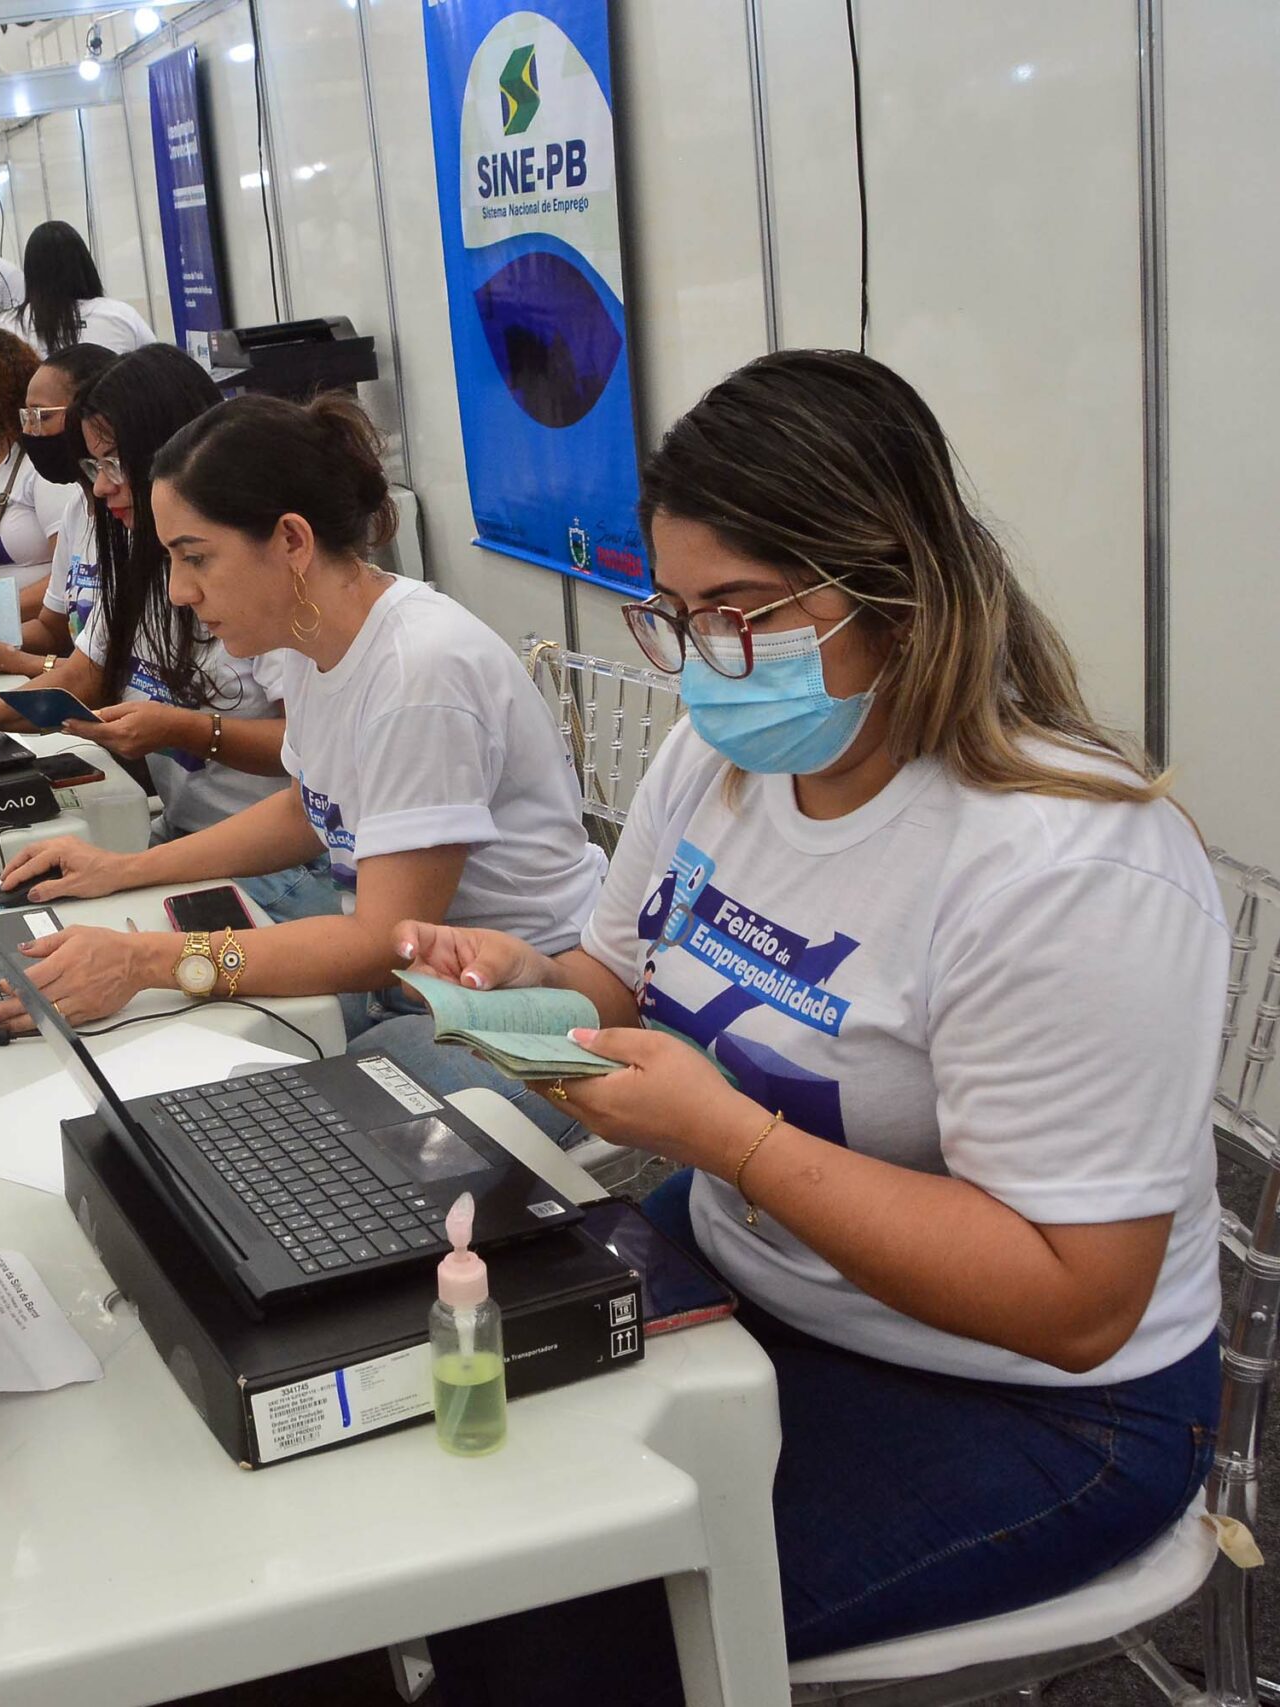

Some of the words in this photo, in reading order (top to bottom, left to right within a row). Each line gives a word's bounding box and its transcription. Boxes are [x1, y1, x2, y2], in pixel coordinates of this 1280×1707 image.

[482, 206, 507, 219] Sistema
[509, 200, 540, 216] Nacional
[542, 199, 551, 213] de
[553, 196, 589, 214] Emprego
[713, 899, 779, 956] Feirão
[775, 946, 791, 965] da
[689, 922, 838, 1026] Empregabilidade
[511, 1343, 558, 1361] Transportadora
